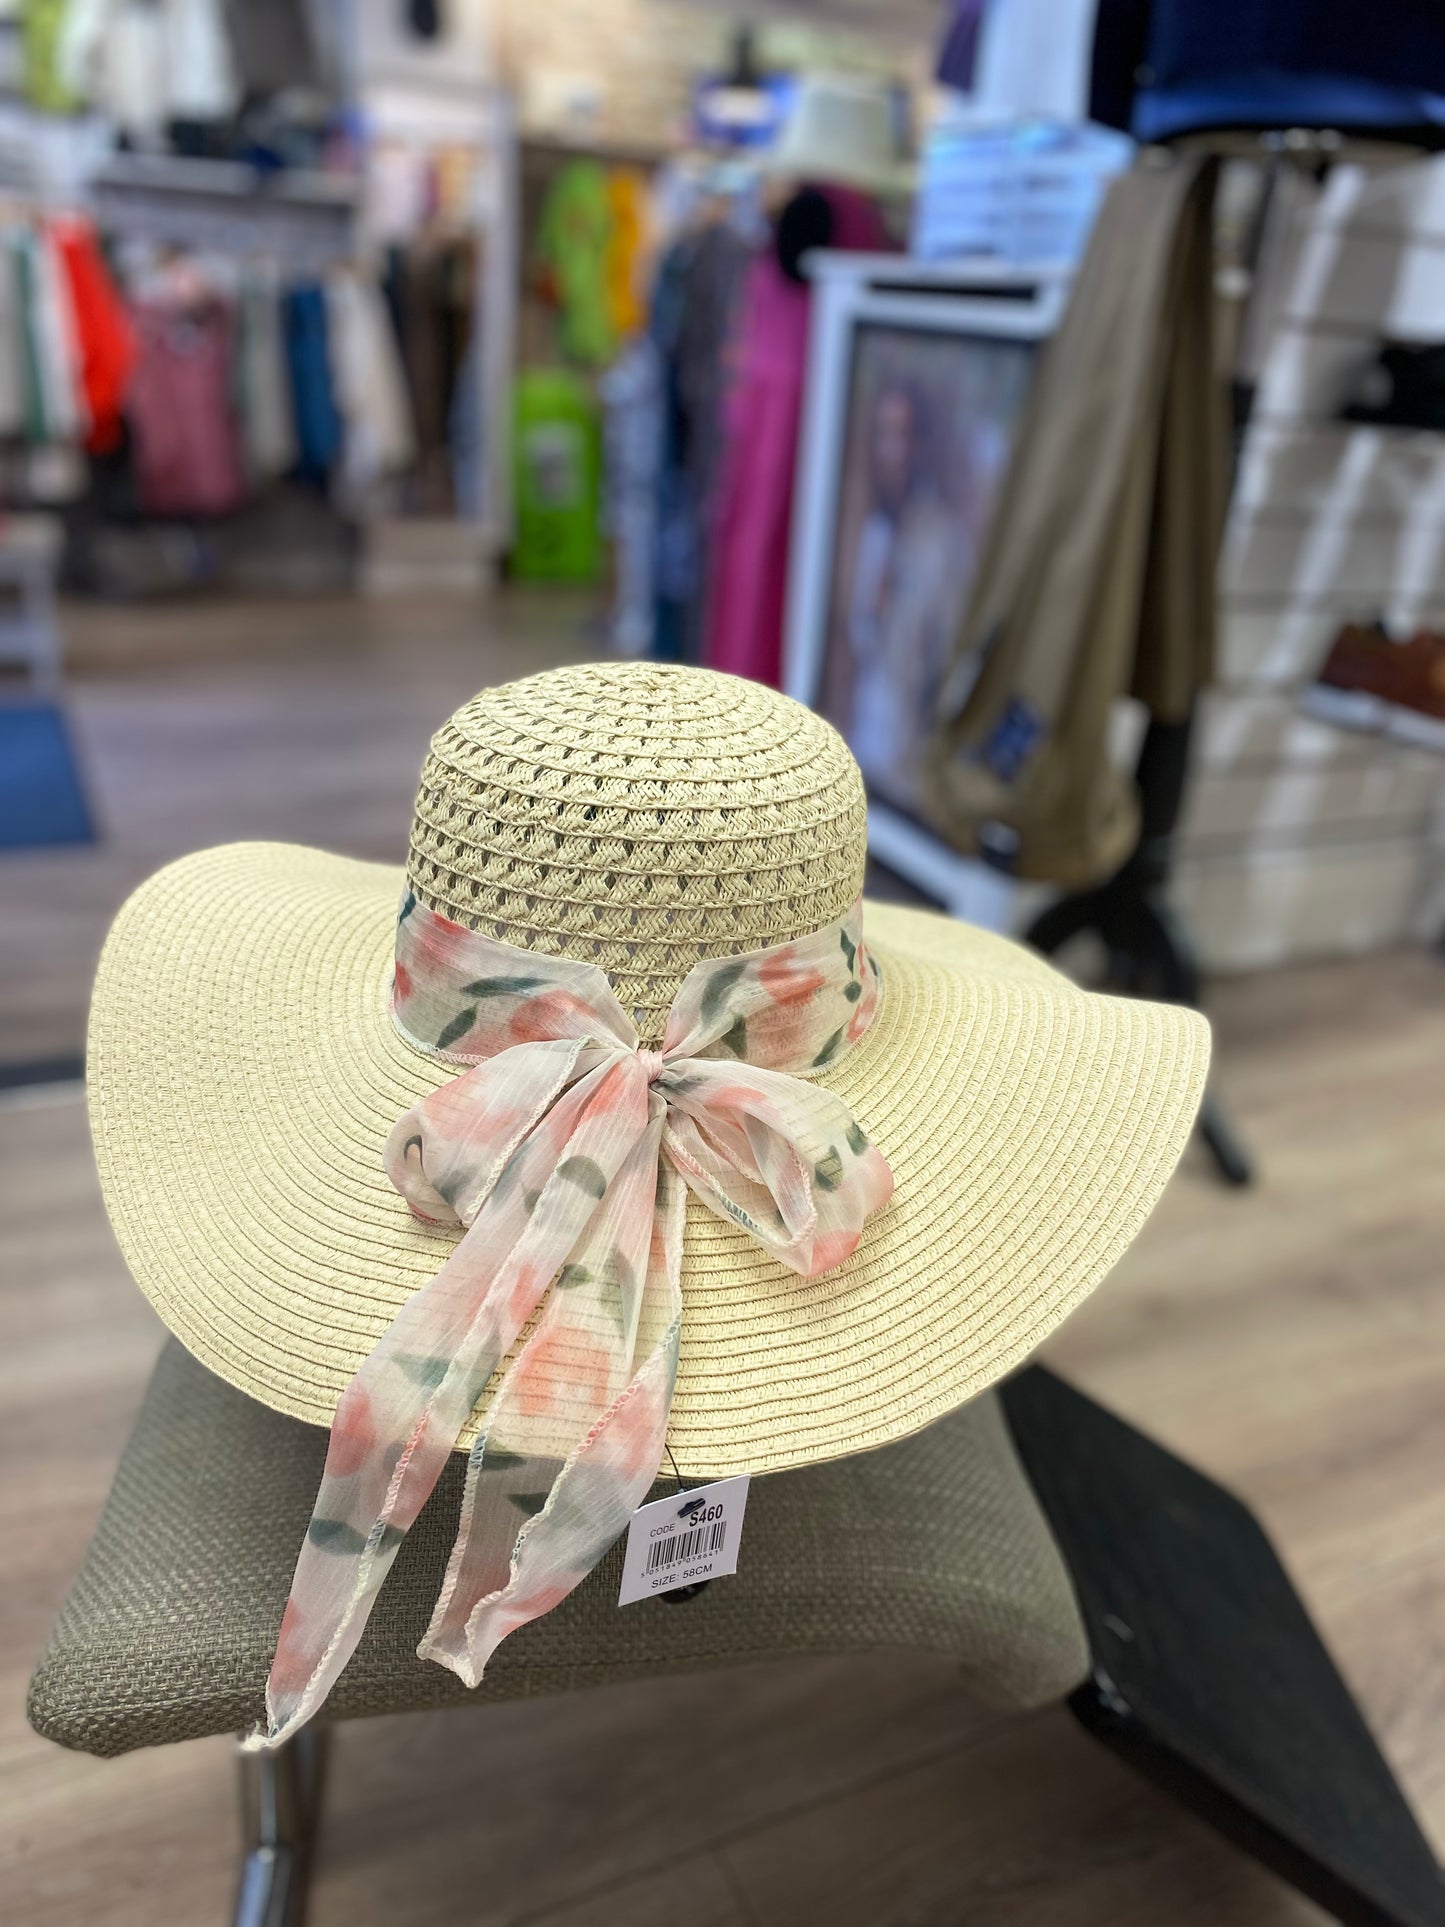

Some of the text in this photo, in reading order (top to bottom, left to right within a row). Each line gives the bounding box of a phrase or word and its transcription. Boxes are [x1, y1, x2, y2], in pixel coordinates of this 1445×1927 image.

[649, 1503, 724, 1538] CODE S460
[651, 1563, 713, 1589] SIZE: 58CM
